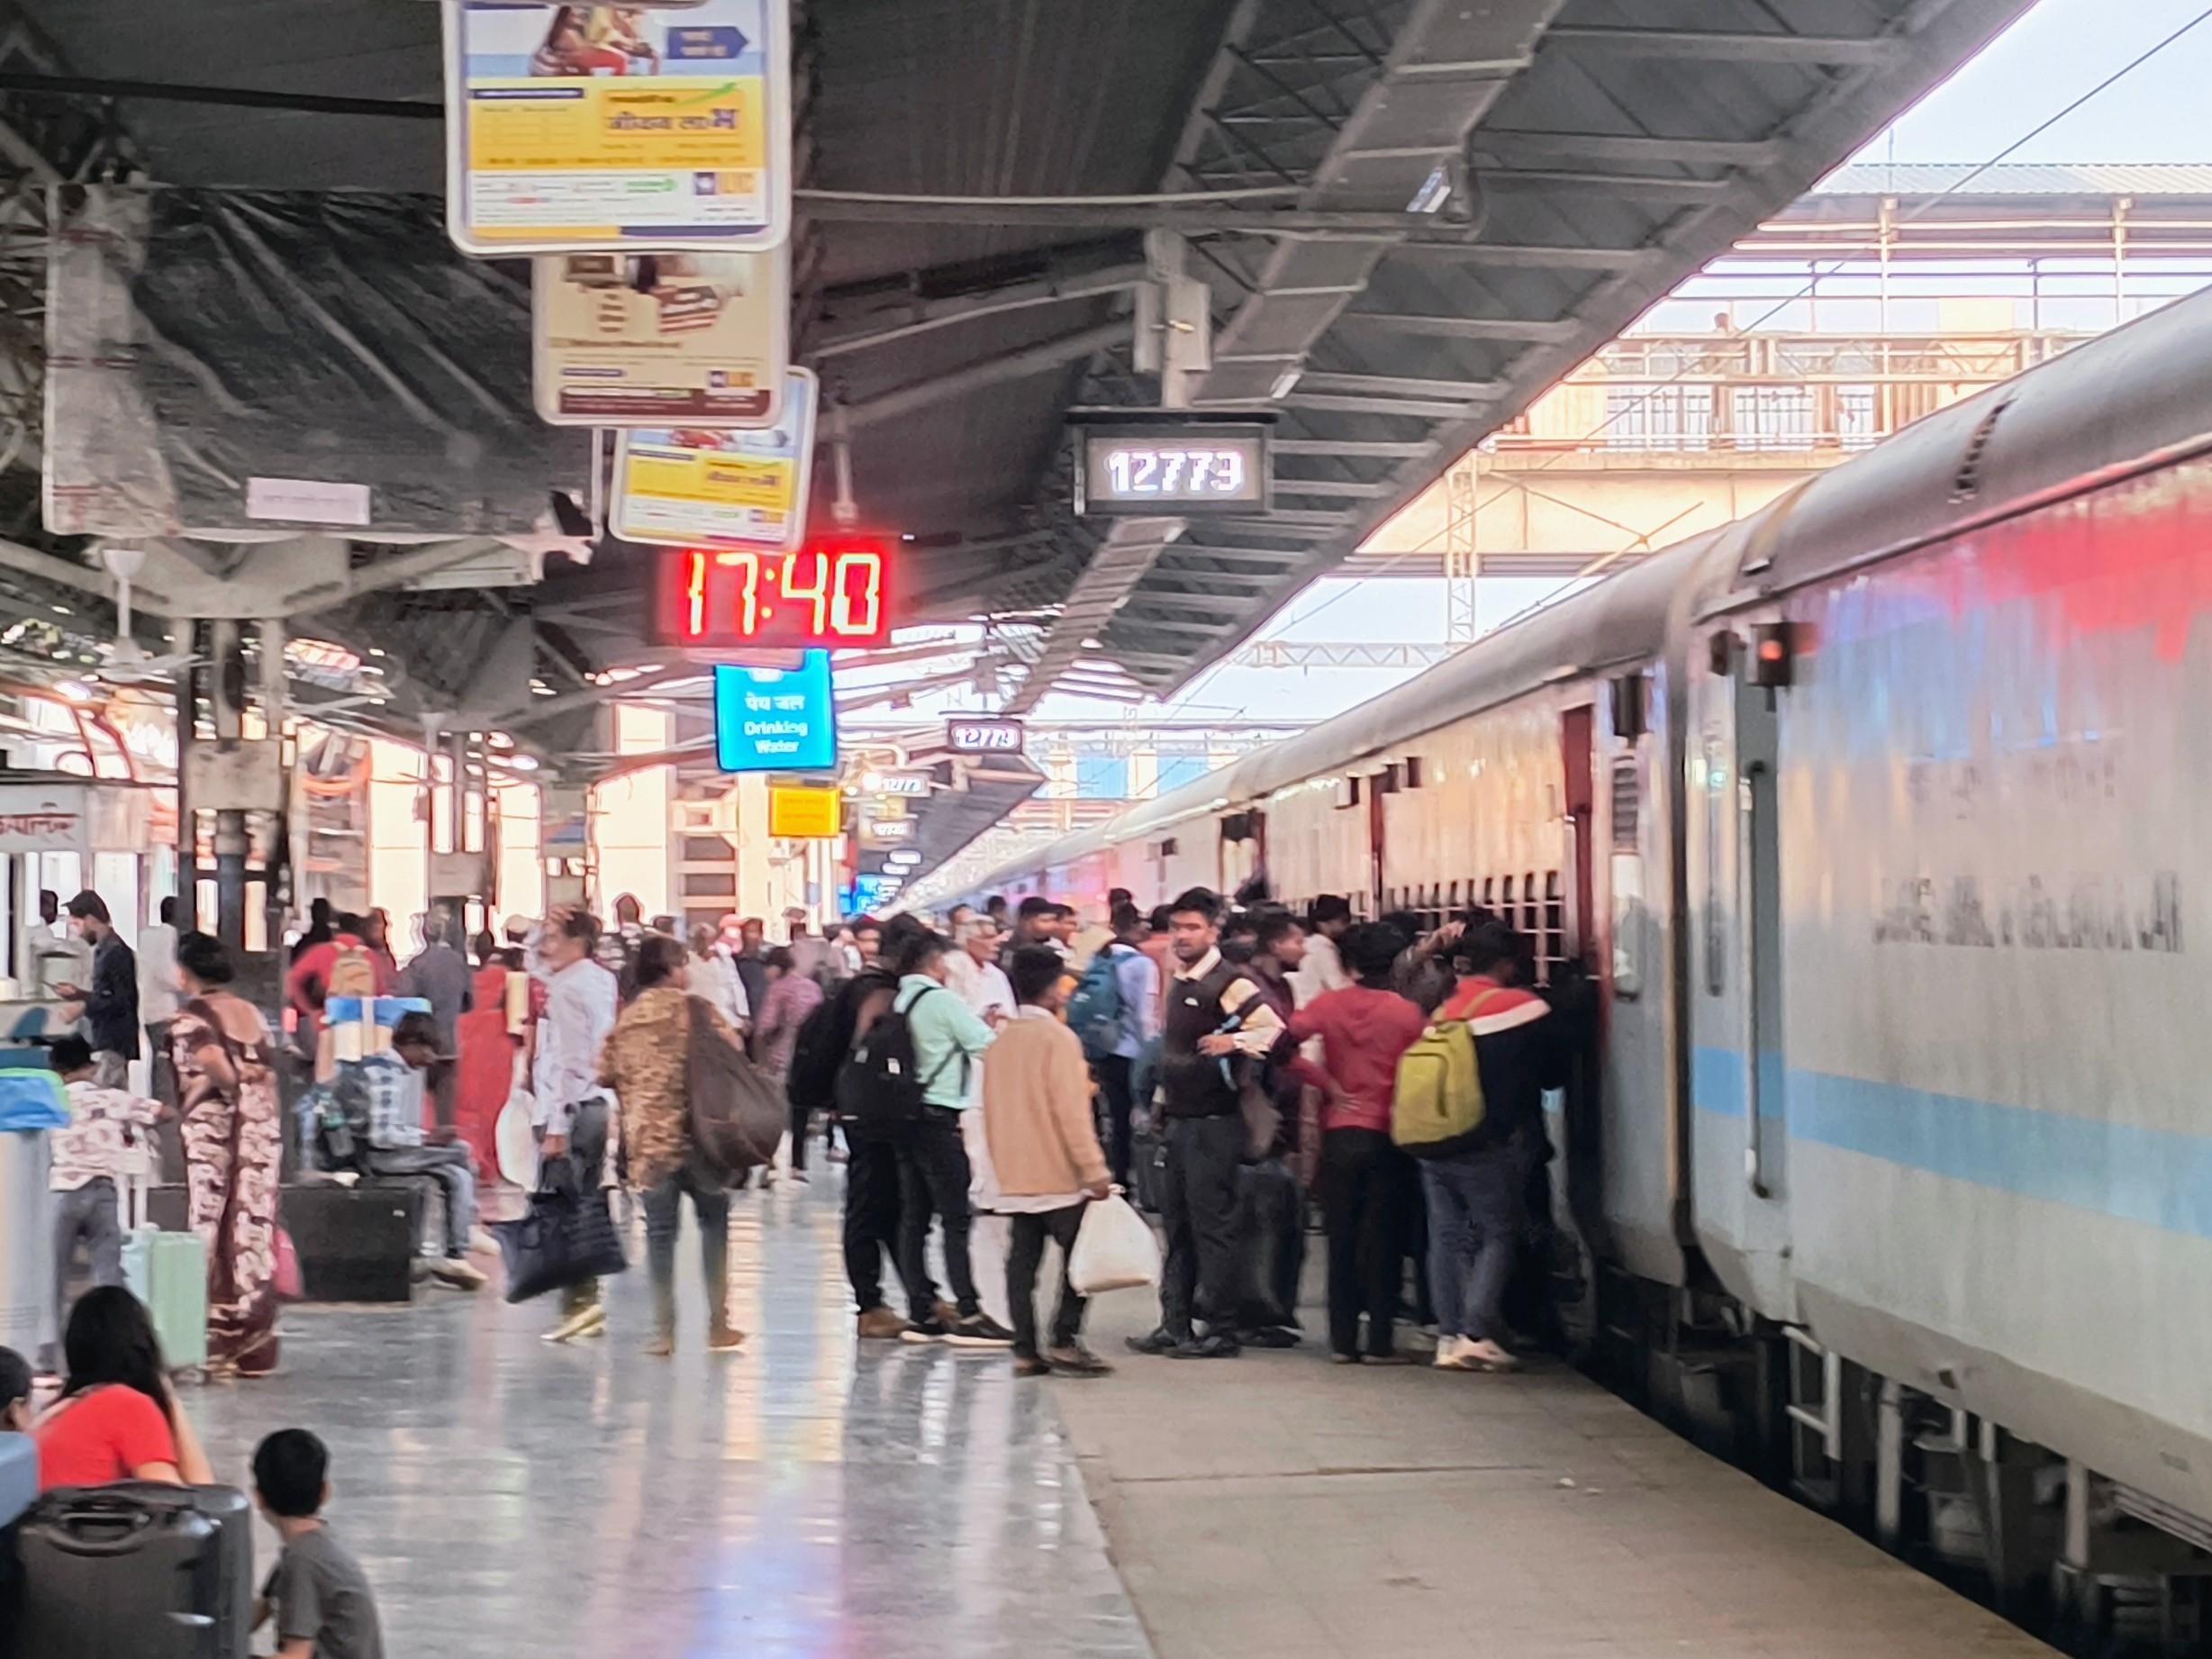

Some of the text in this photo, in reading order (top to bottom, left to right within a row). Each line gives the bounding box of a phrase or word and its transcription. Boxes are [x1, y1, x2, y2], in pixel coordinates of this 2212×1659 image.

[1108, 451, 1243, 492] 12773
[688, 552, 881, 635] 17:40
[744, 721, 808, 737] Drinking
[755, 739, 800, 754] Water
